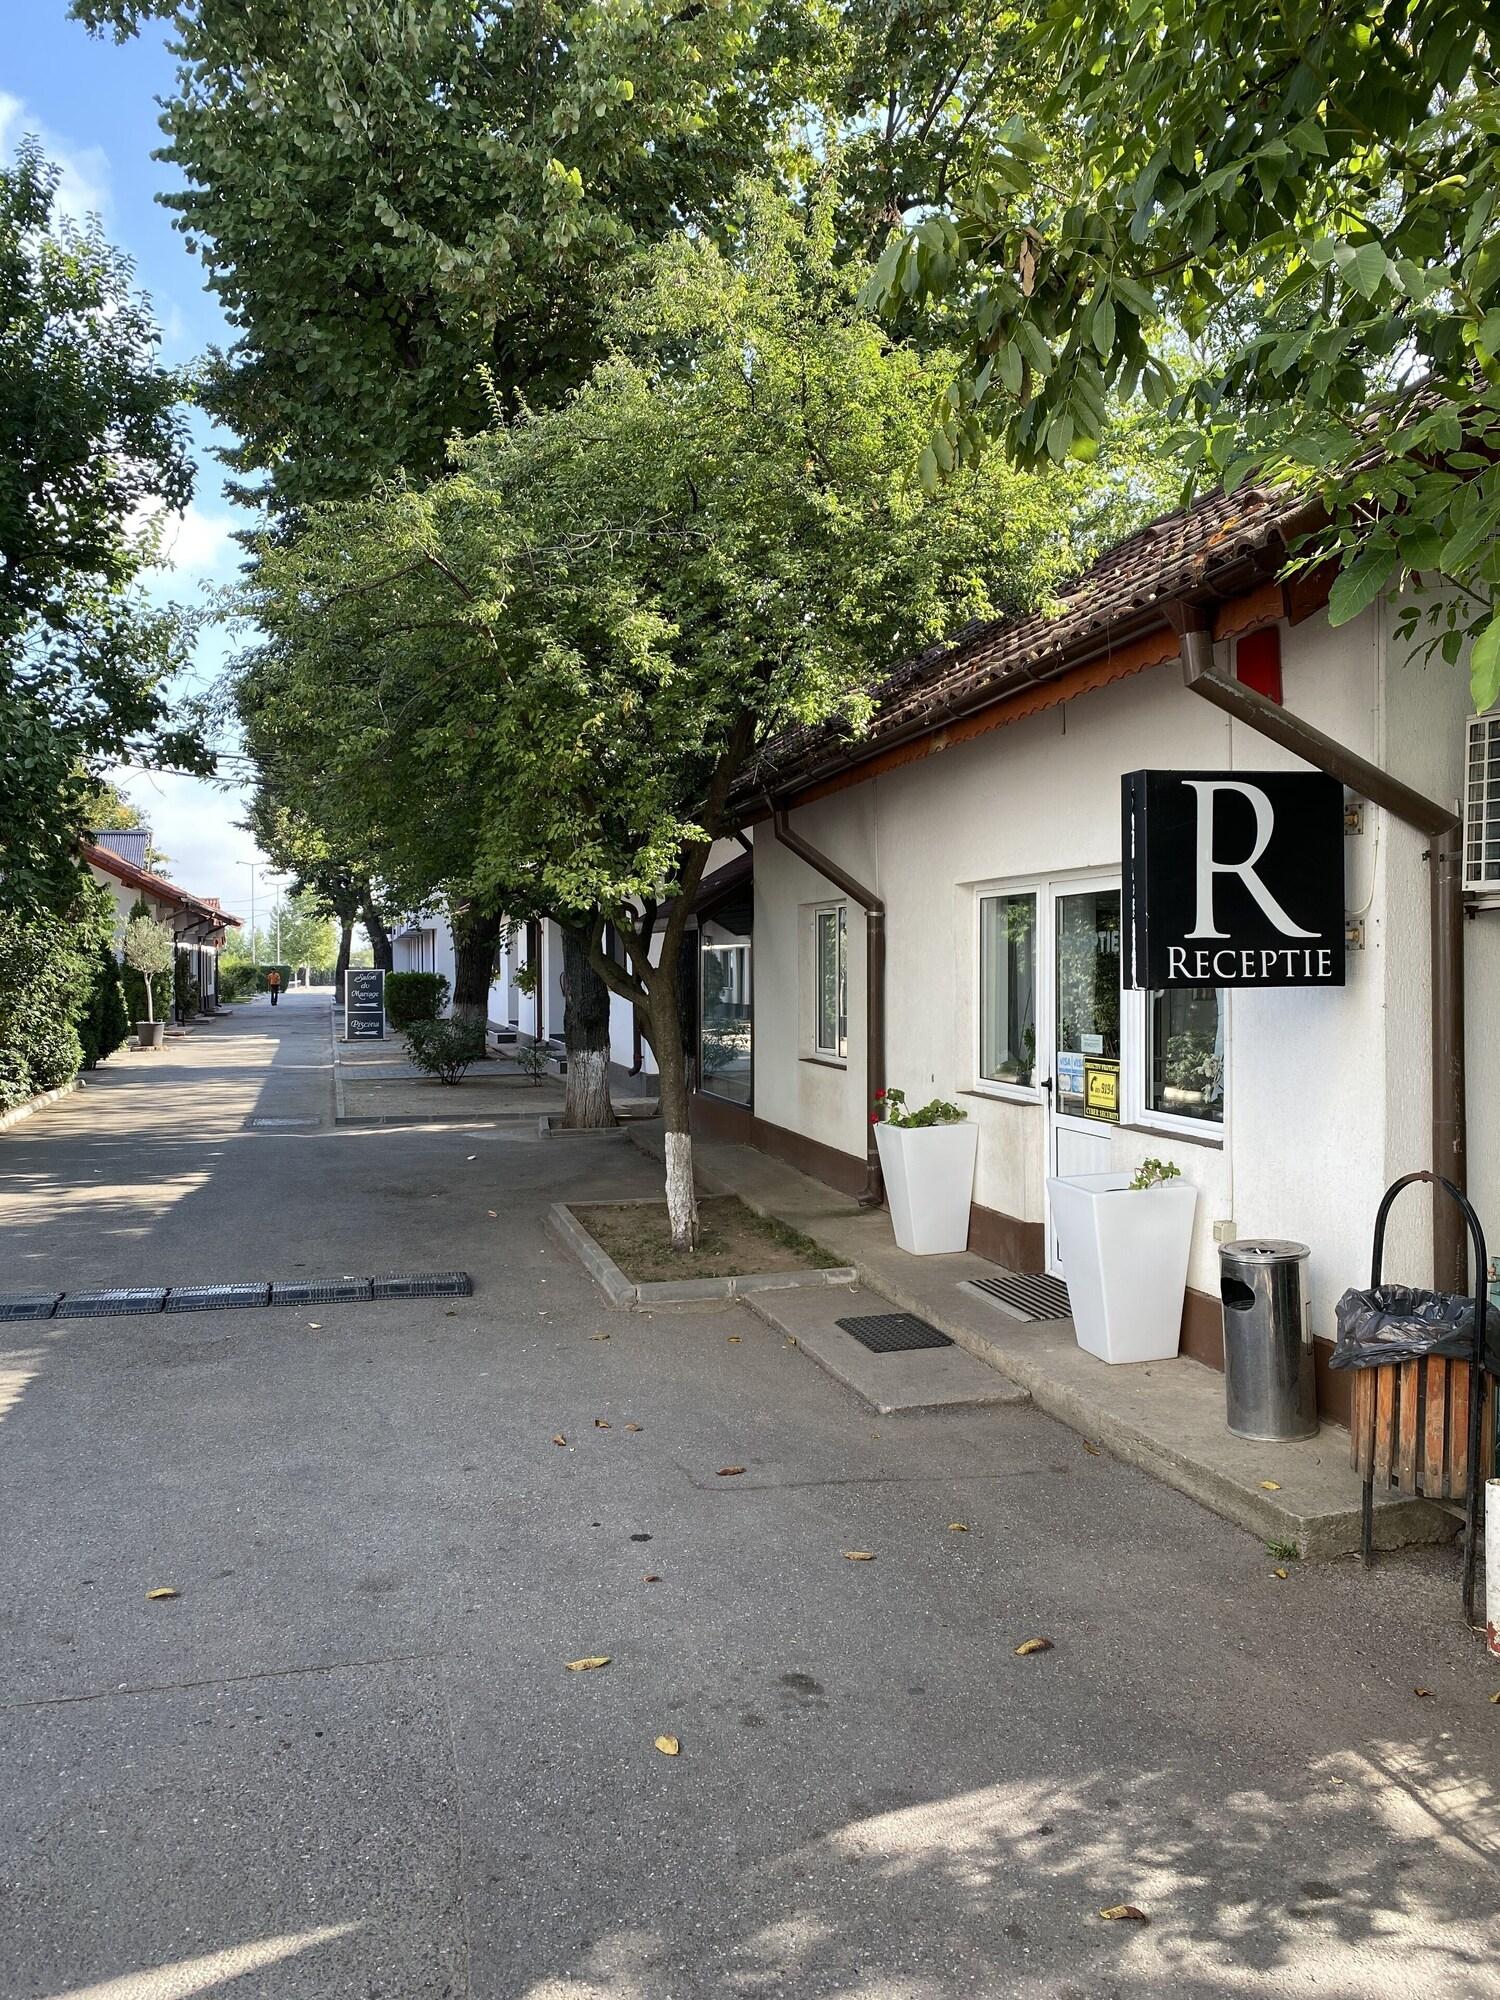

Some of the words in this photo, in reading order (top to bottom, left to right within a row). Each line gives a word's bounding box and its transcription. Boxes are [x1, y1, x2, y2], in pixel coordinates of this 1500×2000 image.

[1181, 780, 1322, 939] R
[1167, 946, 1332, 979] RECEPTIE
[353, 972, 377, 983] Salon
[351, 990, 379, 1000] Mariage
[351, 1020, 379, 1030] Piscina
[1060, 1057, 1071, 1066] VISA
